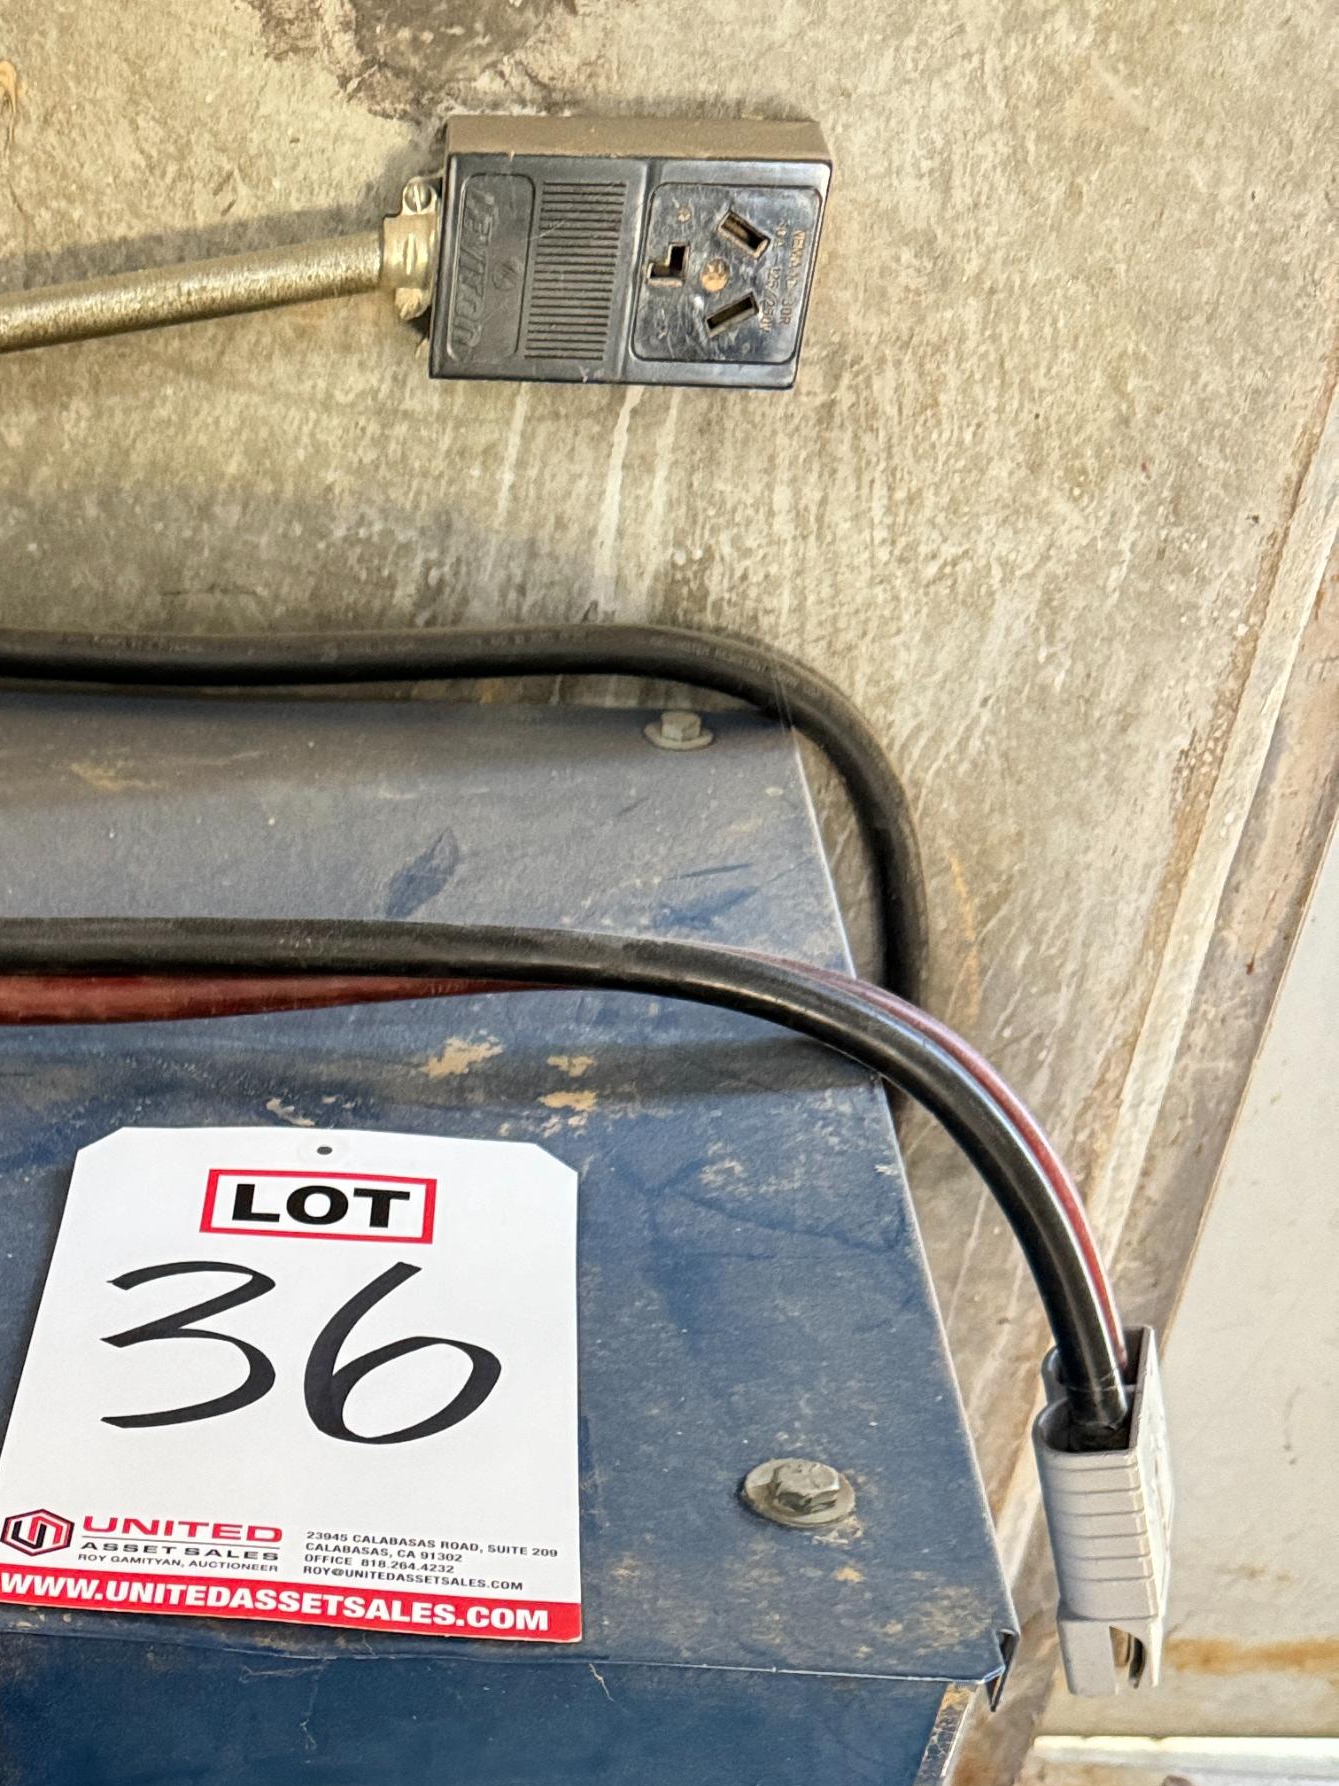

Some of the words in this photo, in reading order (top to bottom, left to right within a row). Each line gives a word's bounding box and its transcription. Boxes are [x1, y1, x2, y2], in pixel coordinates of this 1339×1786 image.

[232, 1184, 411, 1227] LOT
[101, 1261, 502, 1445] 36
[83, 1515, 283, 1543] UNITED
[81, 1541, 176, 1555] ASSET
[184, 1547, 279, 1561] SALES
[306, 1542, 392, 1558] CALABASAS,
[397, 1549, 415, 1559] CA
[420, 1551, 462, 1562] 91302
[307, 1531, 348, 1542] 23945
[353, 1534, 435, 1548] CALABASAS
[440, 1540, 483, 1553] ROAD,
[487, 1544, 528, 1555] SUITE
[532, 1547, 558, 1558] 209
[78, 1553, 106, 1563] ROY
[111, 1555, 185, 1567] GAMITYAN,
[189, 1560, 278, 1573] AUCTIONEER
[304, 1554, 352, 1566] OFFICE
[361, 1558, 454, 1573] 818.264.4232
[303, 1565, 523, 1590] ROY@UNITEDASSETSALES.COM
[0, 1572, 549, 1631] WWW.UNITEDASSETSALES.COM
